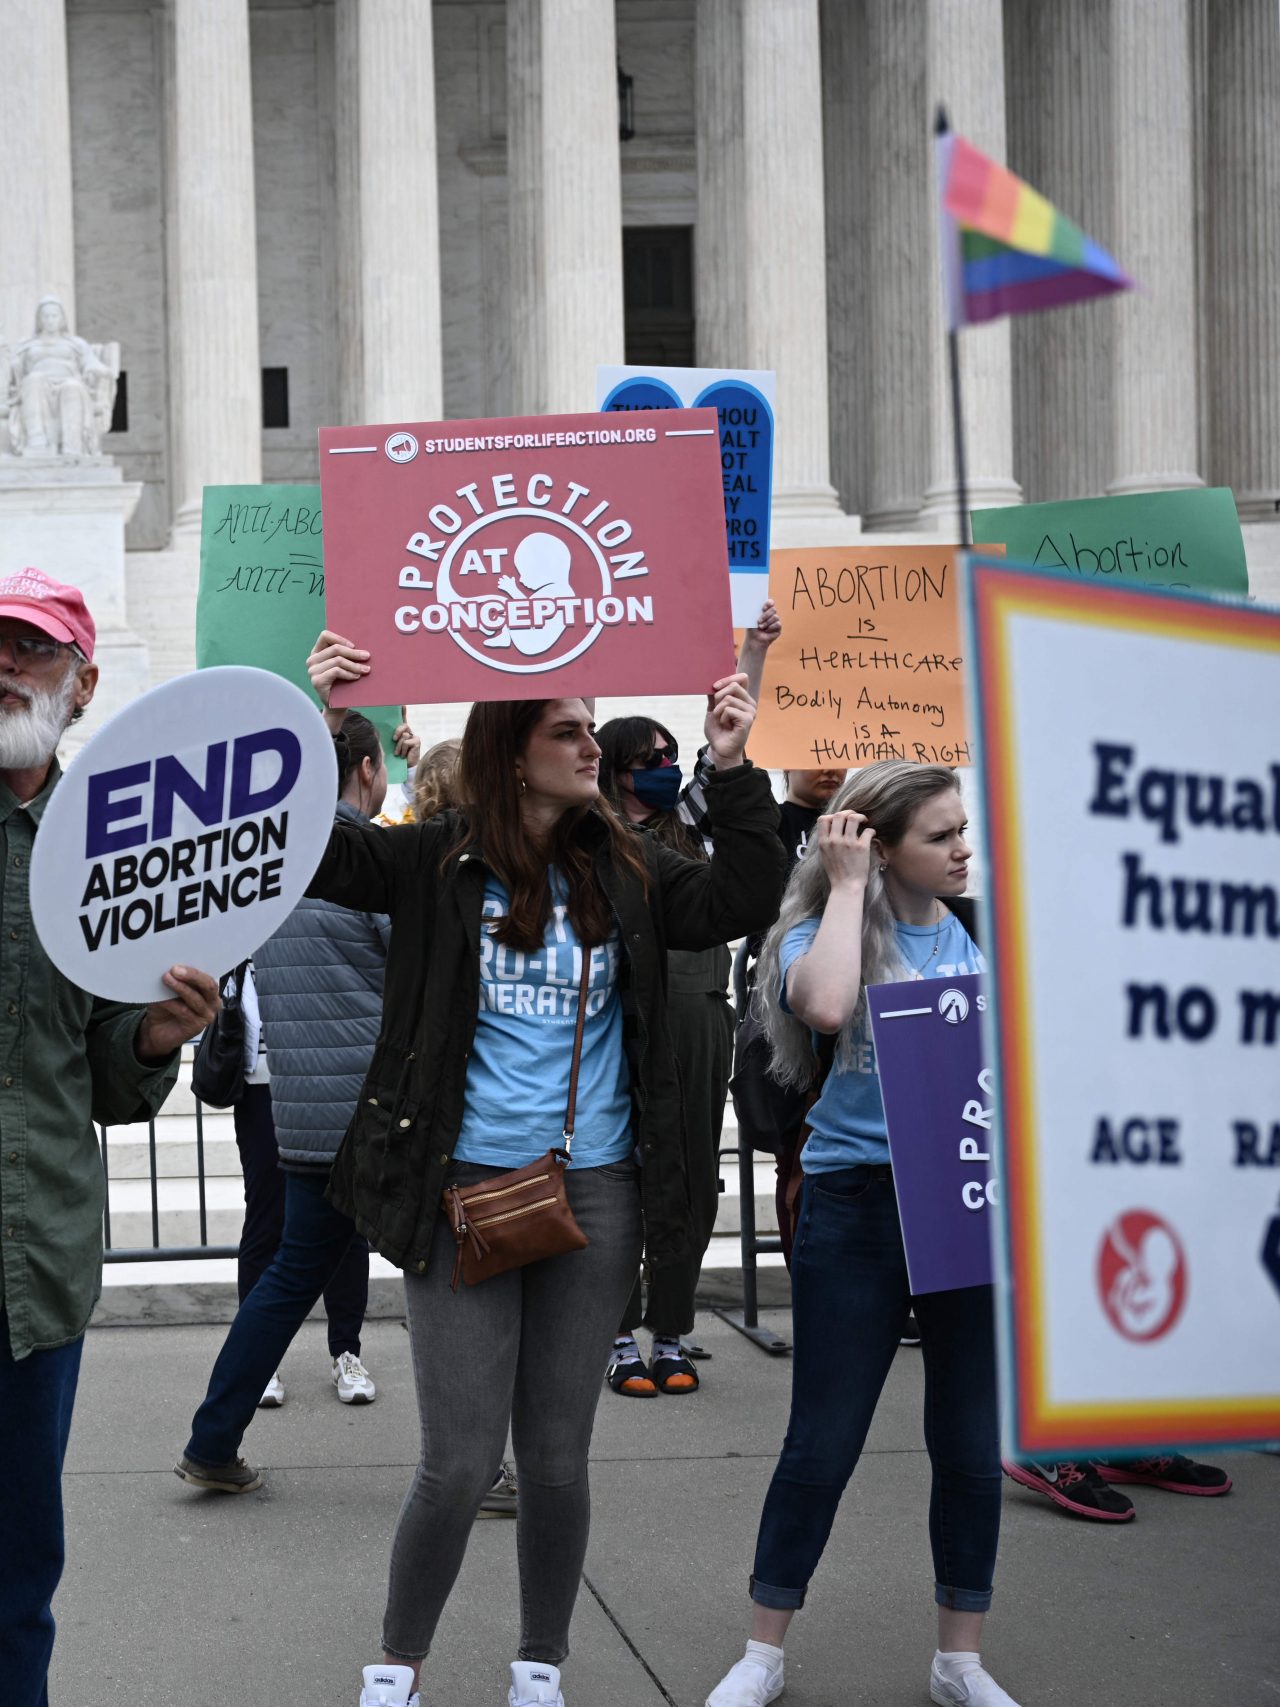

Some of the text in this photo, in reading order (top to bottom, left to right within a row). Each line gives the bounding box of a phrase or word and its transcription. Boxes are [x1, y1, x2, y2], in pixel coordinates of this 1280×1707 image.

[718, 408, 757, 426] HOU
[425, 428, 657, 453] STUDENTSFORLIFEACTION.ORG
[722, 431, 760, 448] ALT
[721, 453, 748, 470] OT
[722, 475, 757, 492] EAL
[398, 473, 650, 590] PROTECTION
[728, 541, 760, 558] HTS
[459, 548, 508, 575] AT
[1032, 532, 1189, 576] Abortion
[792, 565, 948, 611] ABORTION
[395, 596, 654, 633] CONCEPTION
[775, 685, 945, 727] Bodily Autonomy
[880, 724, 900, 738] A
[912, 740, 973, 764] RIGH
[85, 728, 302, 859] END
[1090, 741, 1280, 843] Equal
[80, 811, 289, 907] ABORTION
[79, 858, 283, 952] VIOLENCE
[479, 938, 618, 988] RO-LIF
[1125, 982, 1217, 1043] no
[1089, 1115, 1183, 1166] AGE
[374, 1676, 394, 1684] adidas
